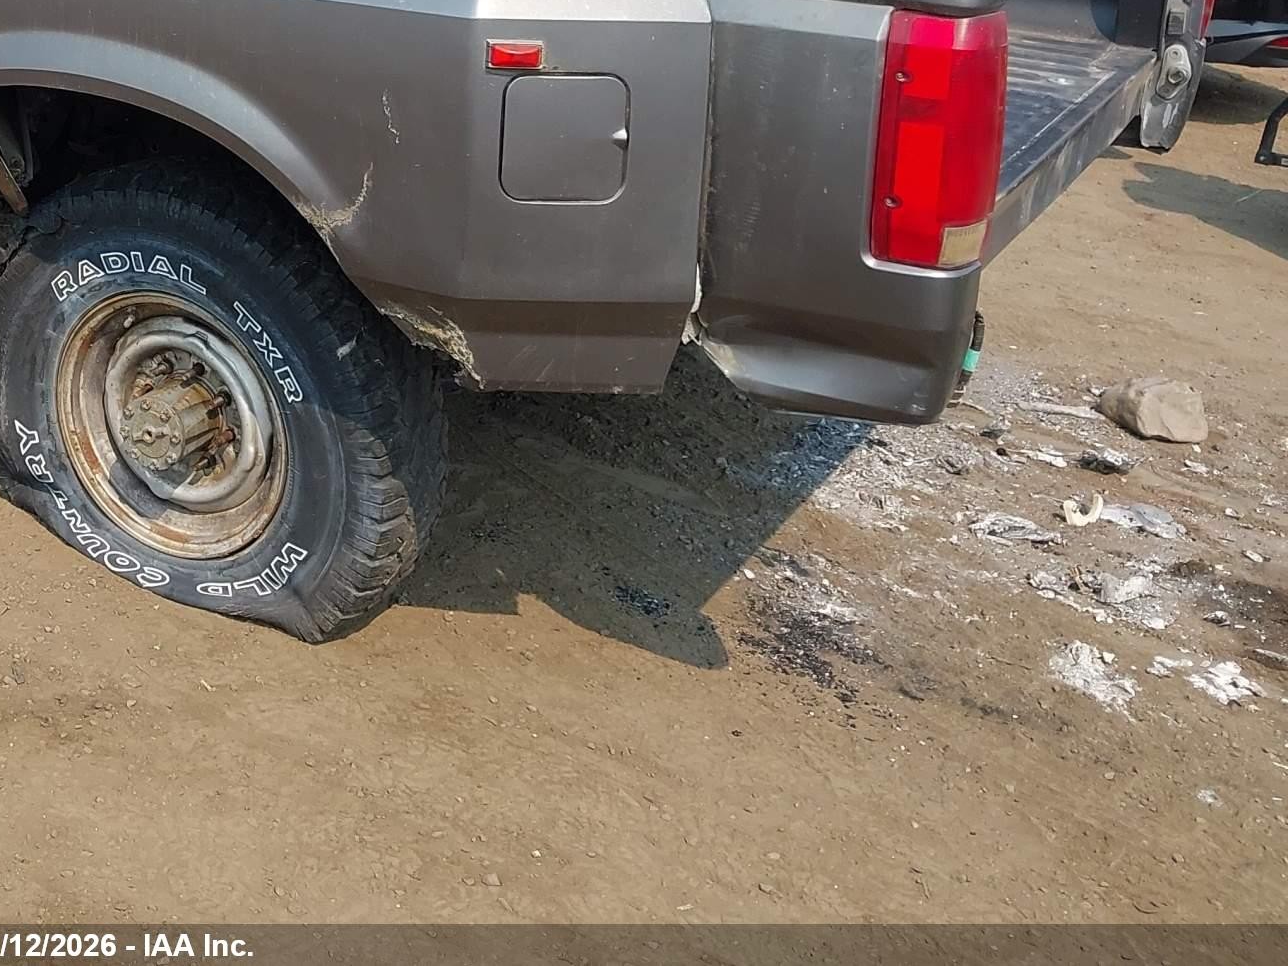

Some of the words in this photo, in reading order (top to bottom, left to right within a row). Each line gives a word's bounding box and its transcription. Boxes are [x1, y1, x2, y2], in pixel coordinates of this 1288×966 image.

[51, 251, 207, 302] RADIAL
[232, 300, 304, 403] TXR
[14, 419, 170, 588] COUNTRY
[196, 542, 308, 597] WILD
